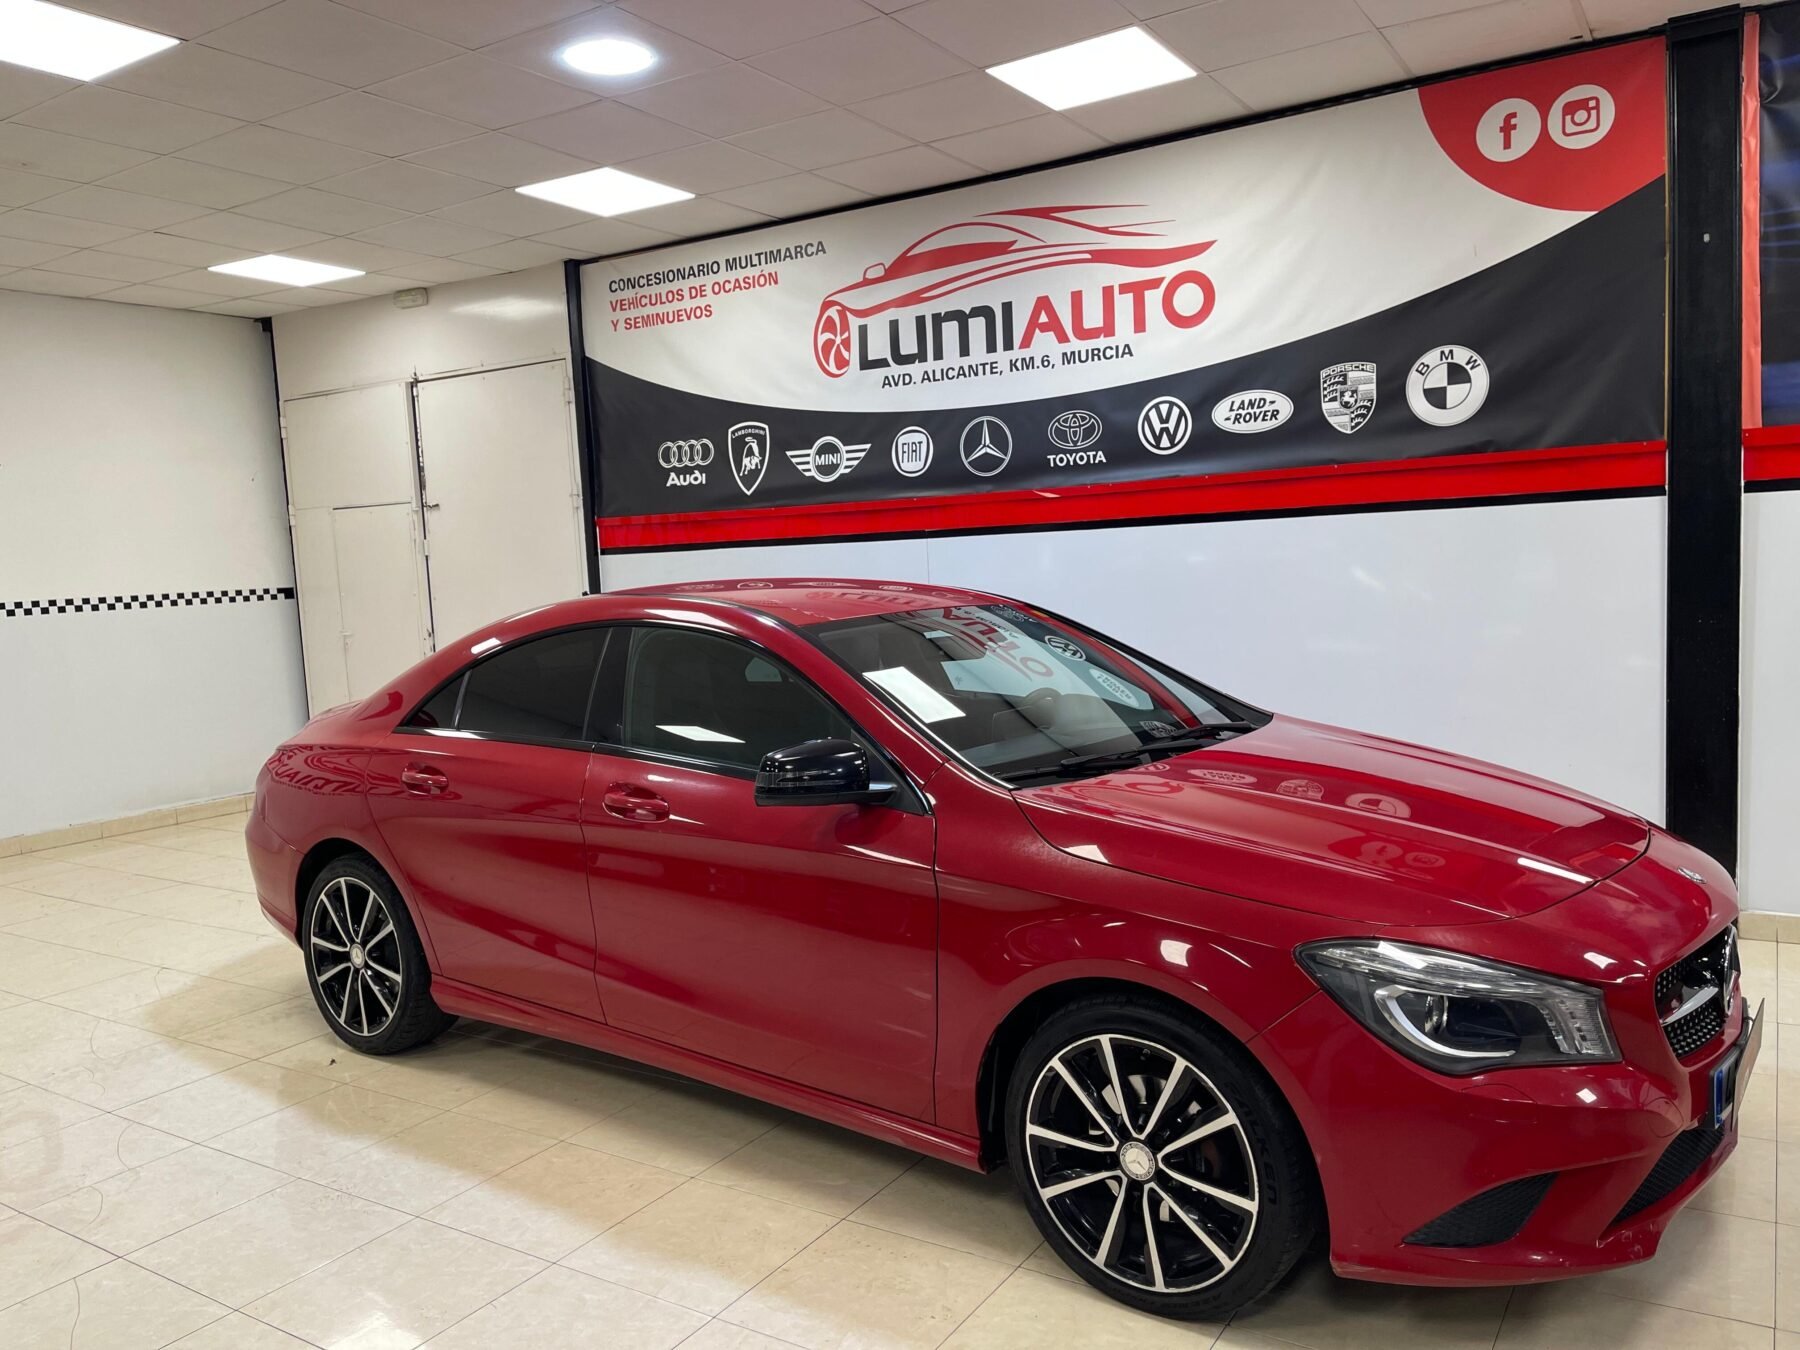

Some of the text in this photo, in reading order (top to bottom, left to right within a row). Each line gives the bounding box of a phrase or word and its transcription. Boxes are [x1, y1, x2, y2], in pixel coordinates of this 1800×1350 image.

[608, 240, 827, 293] CONCESIONARIO MULTIMARCA
[609, 270, 779, 313] VEHÍCULOS DE OCASIÓN
[610, 304, 713, 332] Y SEMINUEVOS
[881, 343, 1134, 388] AVD. ALICANTE, KM.6, MURCIA
[1322, 363, 1374, 378] PORSCHE
[1415, 348, 1481, 376] BMW
[731, 427, 766, 438] LAMBORGHINI
[815, 453, 841, 466] MINI
[901, 440, 924, 464] FIAT
[1047, 450, 1106, 467] TOYOTA
[666, 470, 706, 487] Audi
